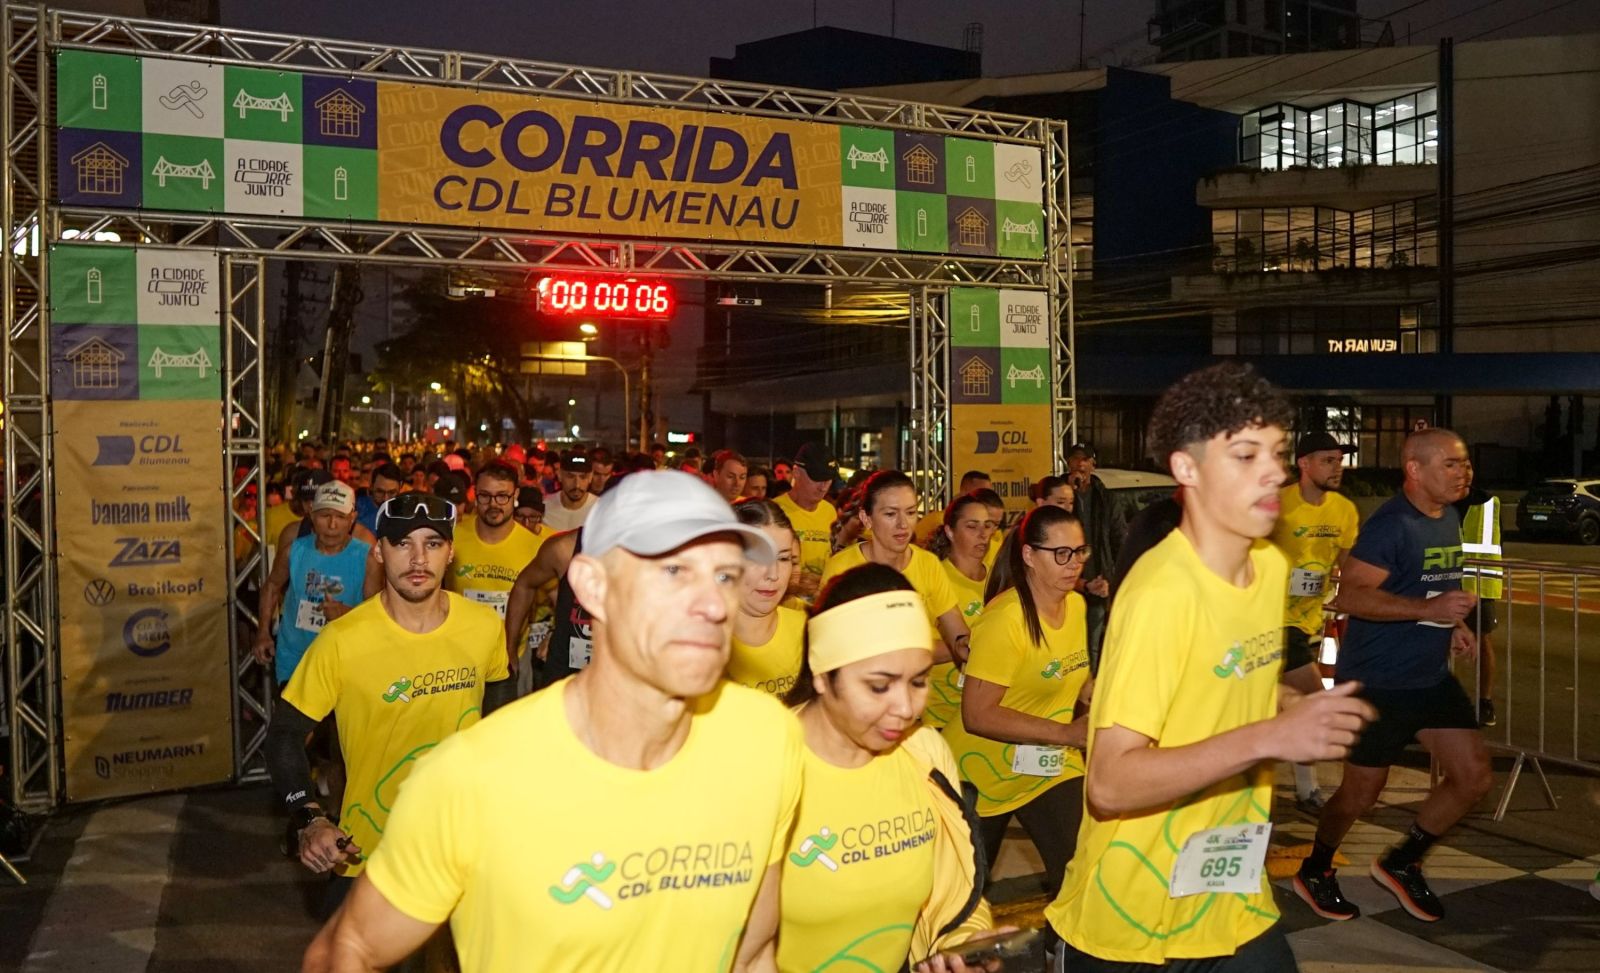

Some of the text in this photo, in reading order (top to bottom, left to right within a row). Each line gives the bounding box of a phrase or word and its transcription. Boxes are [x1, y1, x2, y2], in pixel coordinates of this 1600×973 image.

[440, 104, 799, 189] CORRIDA
[237, 158, 290, 173] A CIDADE
[234, 170, 293, 186] CORRE
[244, 183, 284, 197] JUNTO
[433, 175, 531, 215] CDL
[544, 183, 800, 230] BLUMENAU
[851, 202, 888, 214] A CIDADE
[849, 211, 890, 225] CORRE
[856, 223, 884, 234] JUNTO
[151, 267, 206, 281] A CIDADE
[147, 280, 209, 295] CORRE
[158, 293, 200, 307] JUNTO
[551, 281, 668, 313] 00 00 06
[1007, 304, 1040, 315] A CIDADE
[1005, 313, 1043, 325] CORRE
[1012, 323, 1037, 334] JUNTO
[139, 433, 184, 453] CDL
[1002, 431, 1029, 445] CDL
[91, 495, 191, 525] banana milk
[108, 537, 182, 567] ZATA
[128, 578, 204, 596] Breitkopf
[413, 666, 476, 690] CORRIDA
[411, 680, 476, 698] CDL BLUMENAU
[113, 742, 205, 765] NEUMARKT
[841, 807, 936, 850] CORRIDA
[841, 827, 936, 865] CDL BLUMENAU
[620, 842, 753, 881] CORRIDA
[1200, 856, 1242, 878] 695
[617, 869, 753, 900] CDL BLUMENAU
